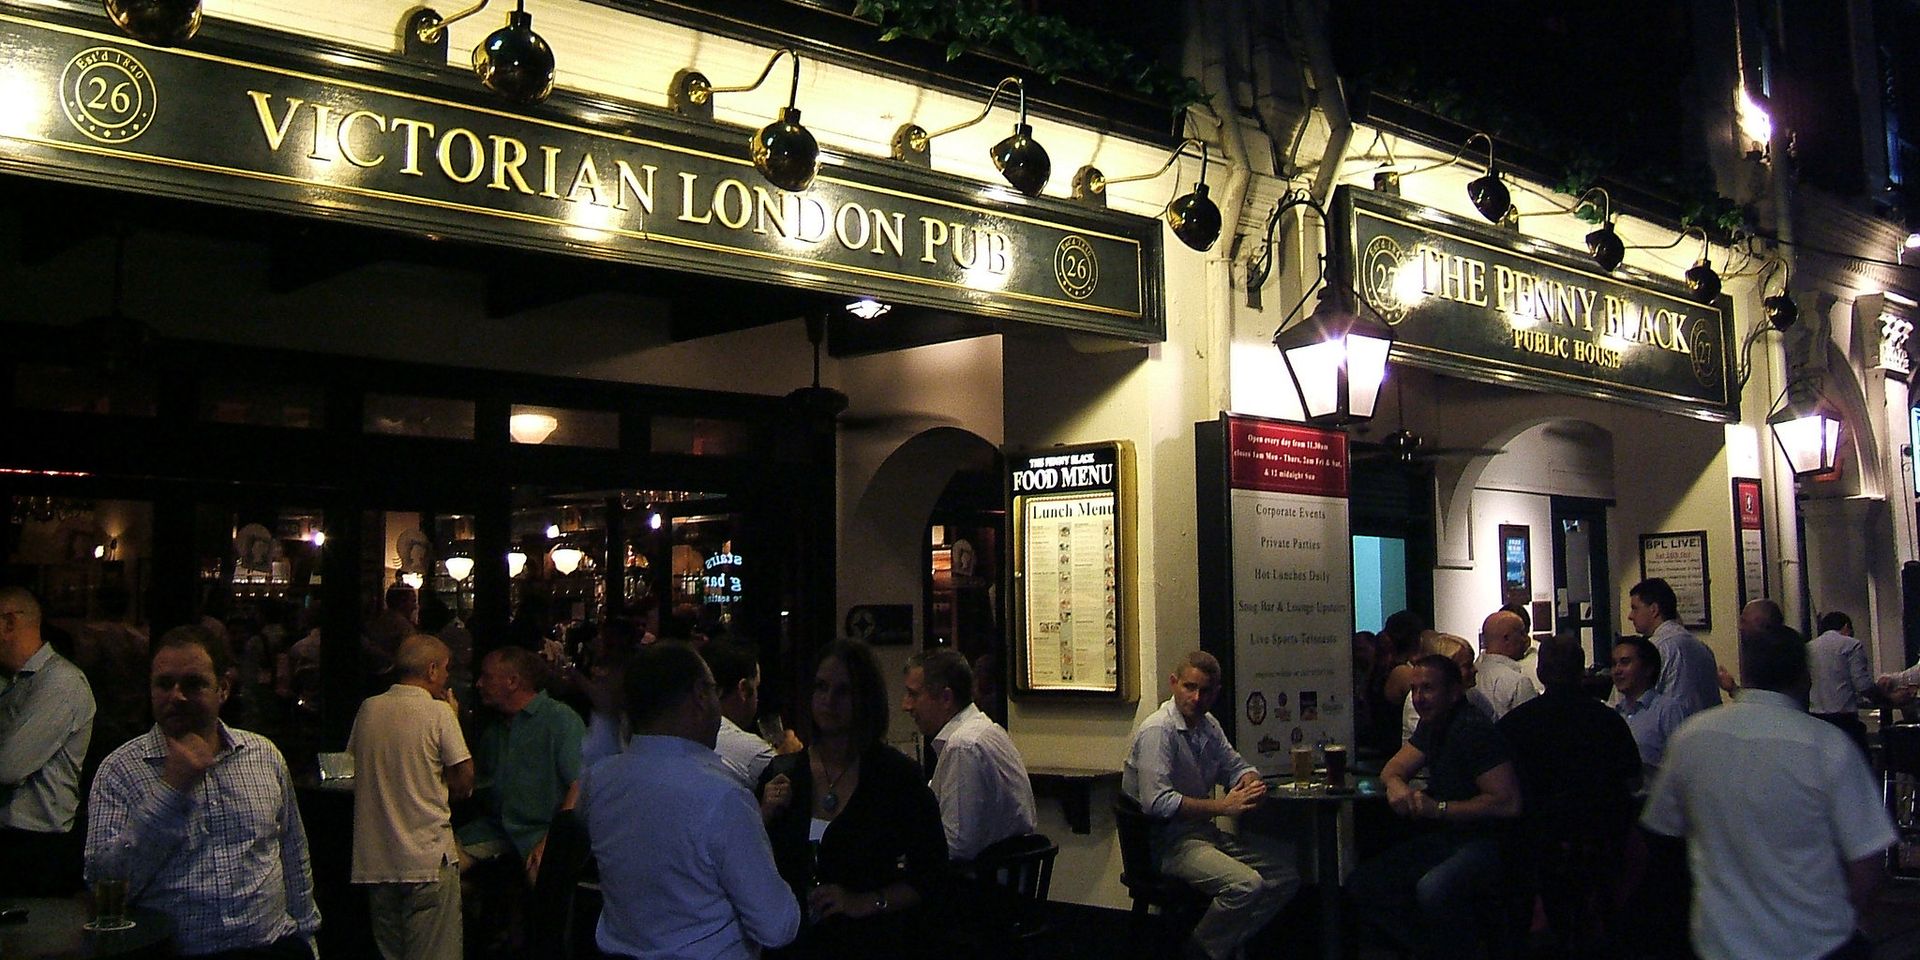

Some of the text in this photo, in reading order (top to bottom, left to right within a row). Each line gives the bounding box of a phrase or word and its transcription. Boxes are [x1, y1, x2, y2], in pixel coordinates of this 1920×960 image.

[76, 51, 145, 79] Est'd 1840
[87, 77, 131, 113] 26
[246, 90, 1011, 275] VICTORIAN LONDON PUB
[1066, 255, 1087, 279] 26
[1376, 264, 1401, 303] 27
[1414, 243, 1691, 354] THE PENNY BLACK
[1512, 328, 1622, 369] PUBLIC HOUSE
[1698, 341, 1712, 364] 27
[1248, 434, 1263, 443] Open
[1264, 437, 1280, 446] every
[1281, 438, 1291, 448] day
[1292, 439, 1306, 448] from
[1266, 452, 1278, 460] Mon
[1013, 463, 1113, 491] FOOD MENU
[1279, 471, 1304, 480] midnight
[1033, 502, 1114, 519] Lunch Menu
[1256, 504, 1326, 519] Corporate Events
[1261, 536, 1320, 549] Private Parties
[1645, 540, 1668, 549] BPL
[1255, 568, 1330, 583] Hot Lunches Daily
